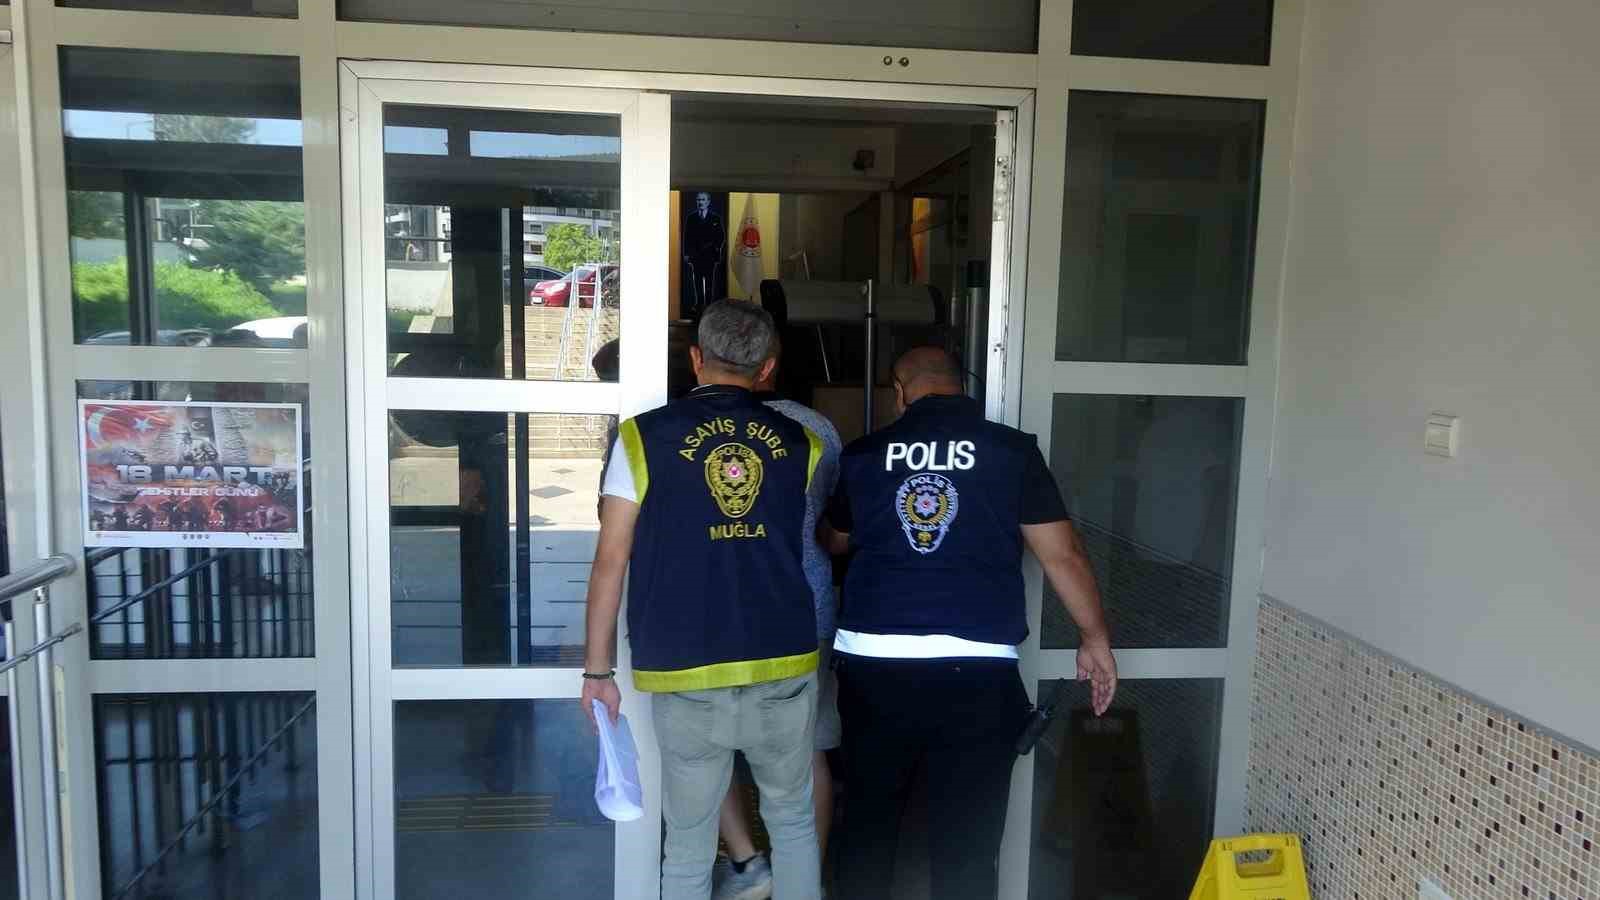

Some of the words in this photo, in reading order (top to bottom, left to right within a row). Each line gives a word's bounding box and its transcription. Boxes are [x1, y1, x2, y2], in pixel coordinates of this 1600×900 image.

[680, 417, 736, 461] ASAYİŞ
[746, 421, 787, 459] ŞUBE
[116, 464, 152, 483] 18
[164, 465, 272, 485] MART
[709, 521, 767, 540] MUĞLA
